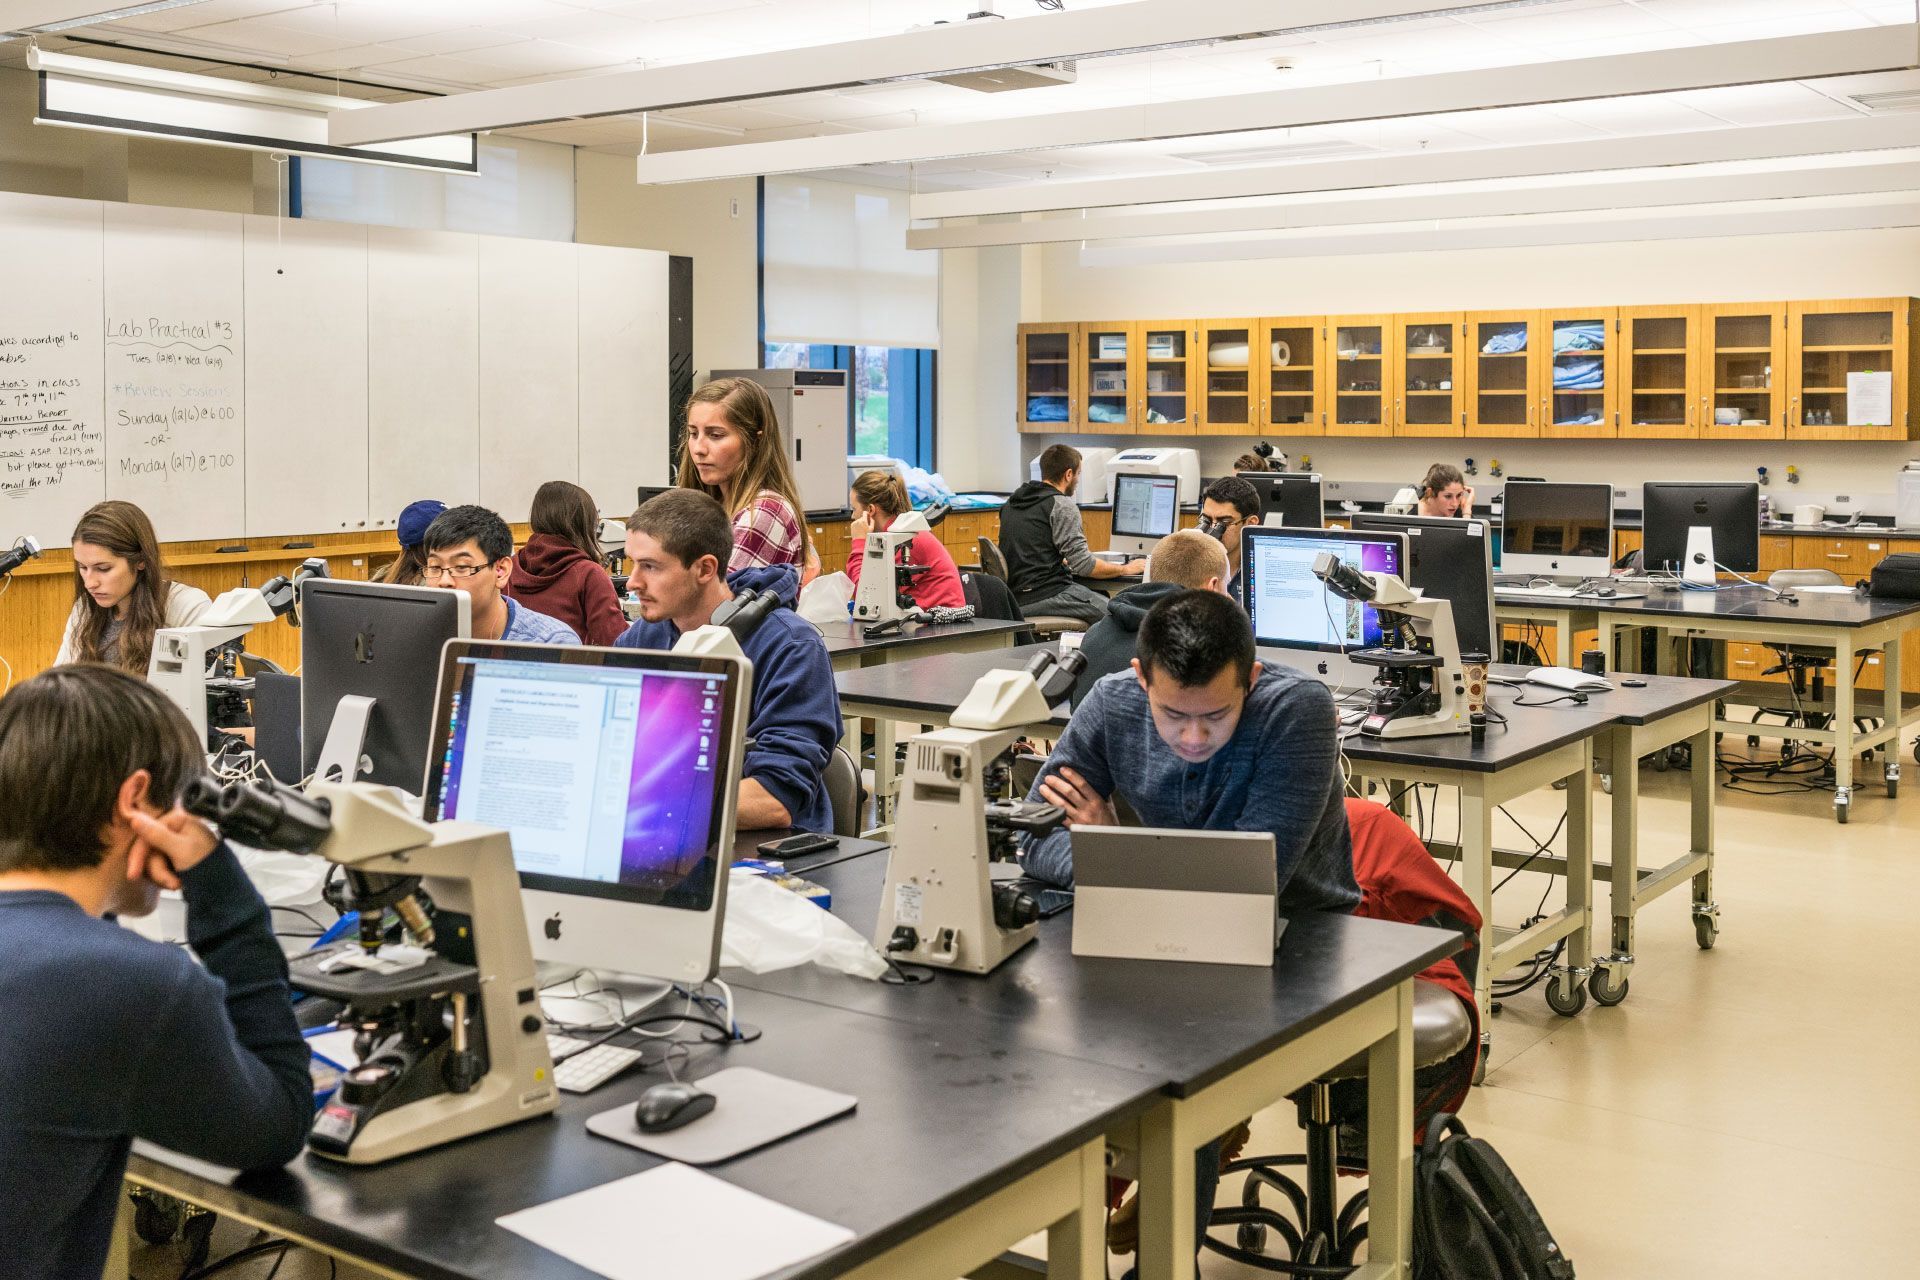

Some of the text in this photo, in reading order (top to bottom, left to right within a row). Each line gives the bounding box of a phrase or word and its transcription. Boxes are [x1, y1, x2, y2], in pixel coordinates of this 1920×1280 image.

[107, 317, 143, 338] Lab
[148, 317, 211, 339] Practical
[70, 332, 79, 341] to
[126, 353, 151, 363] Tues
[38, 380, 49, 388] in
[52, 379, 81, 388] class
[117, 409, 169, 432] Sunday
[52, 423, 68, 432] due
[72, 422, 87, 432] at
[120, 457, 168, 482] Monday
[1, 479, 24, 490] email
[29, 477, 41, 488] the
